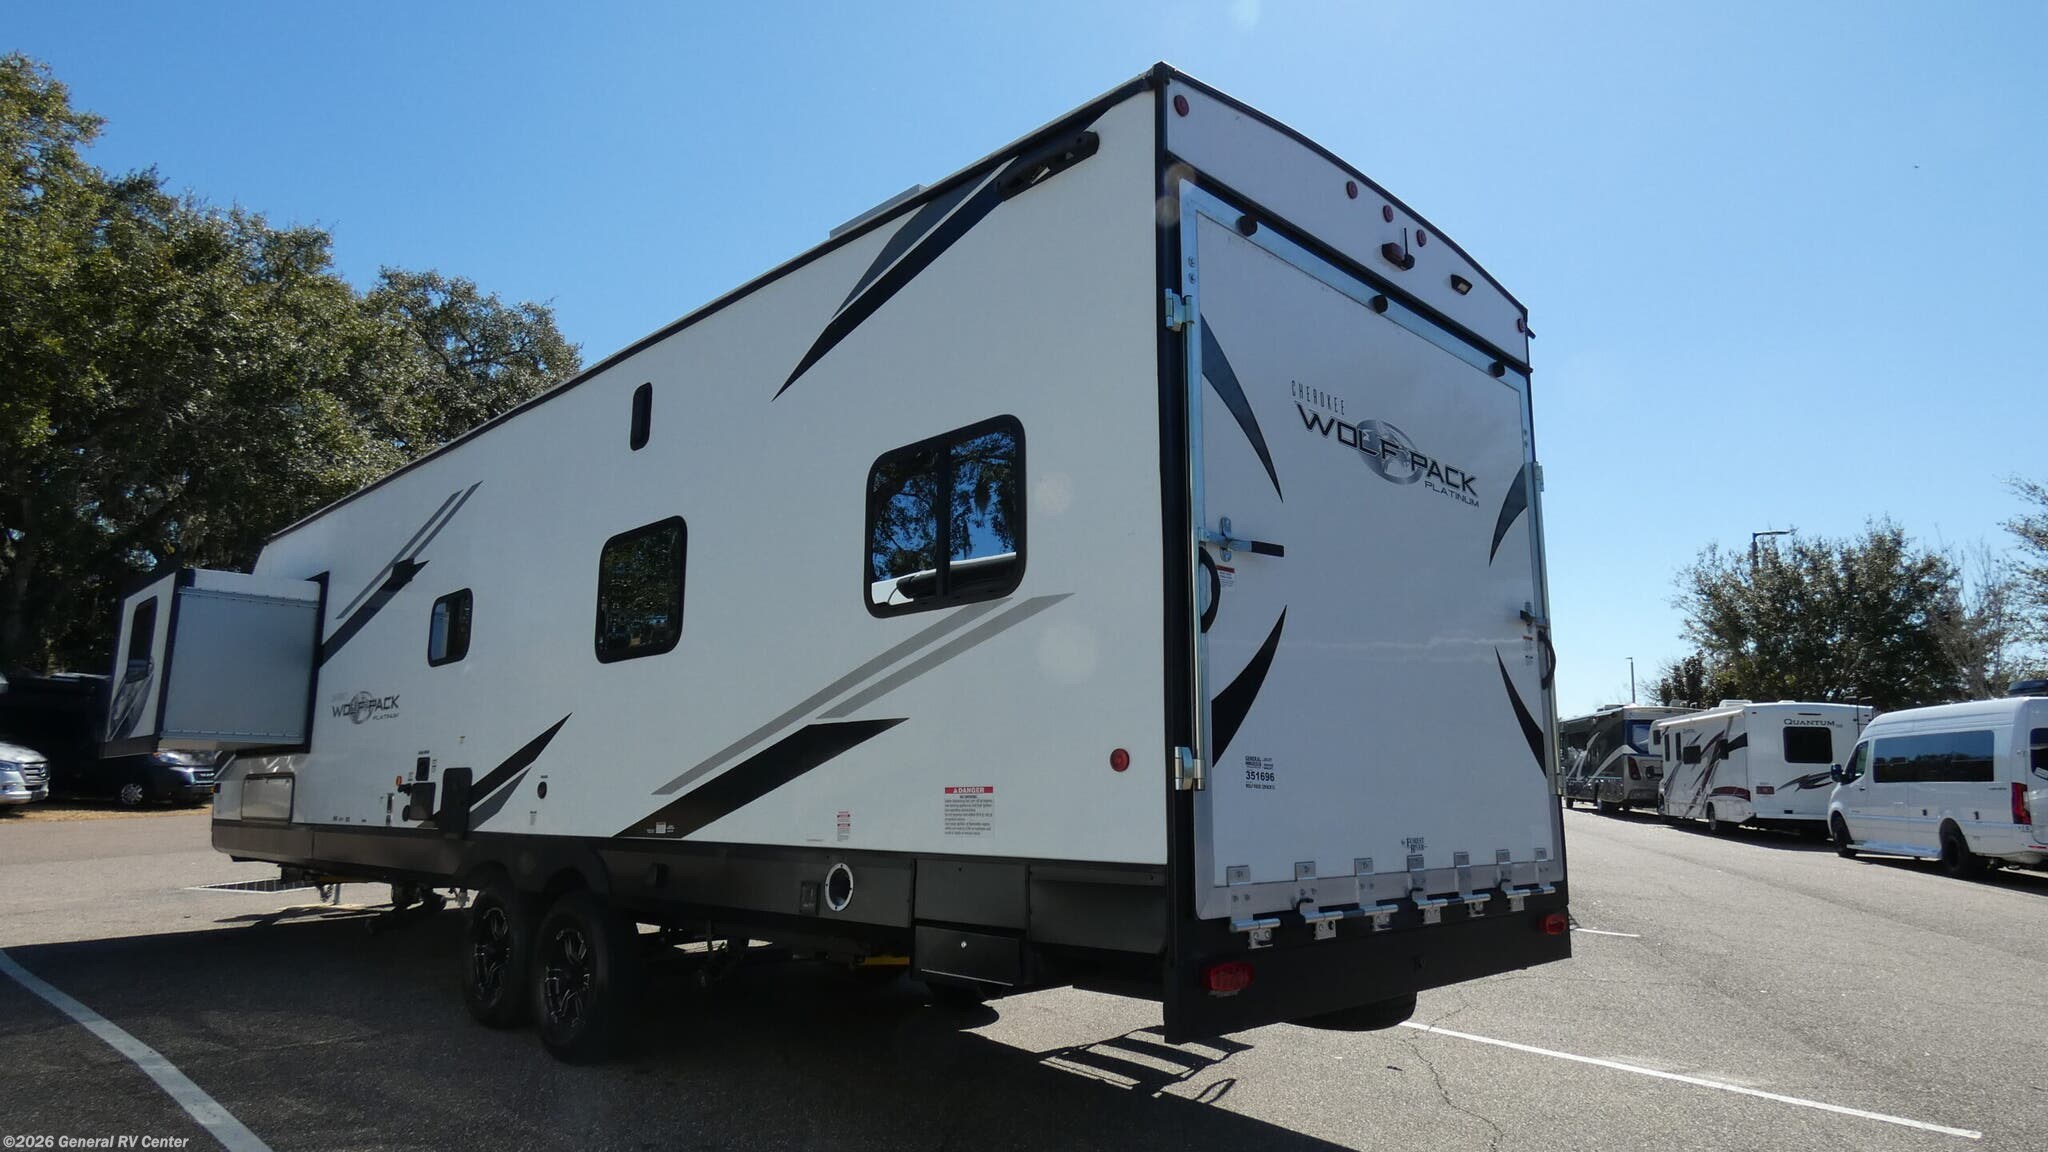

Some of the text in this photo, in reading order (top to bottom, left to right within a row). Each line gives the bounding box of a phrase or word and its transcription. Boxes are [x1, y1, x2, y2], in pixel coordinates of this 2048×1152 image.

[1291, 379, 1345, 416] CHEROKEE
[1295, 401, 1478, 497] WOLF PACK
[1424, 480, 1480, 509] PLATINUM
[369, 694, 400, 711] PACK
[1245, 770, 1275, 782] 351696
